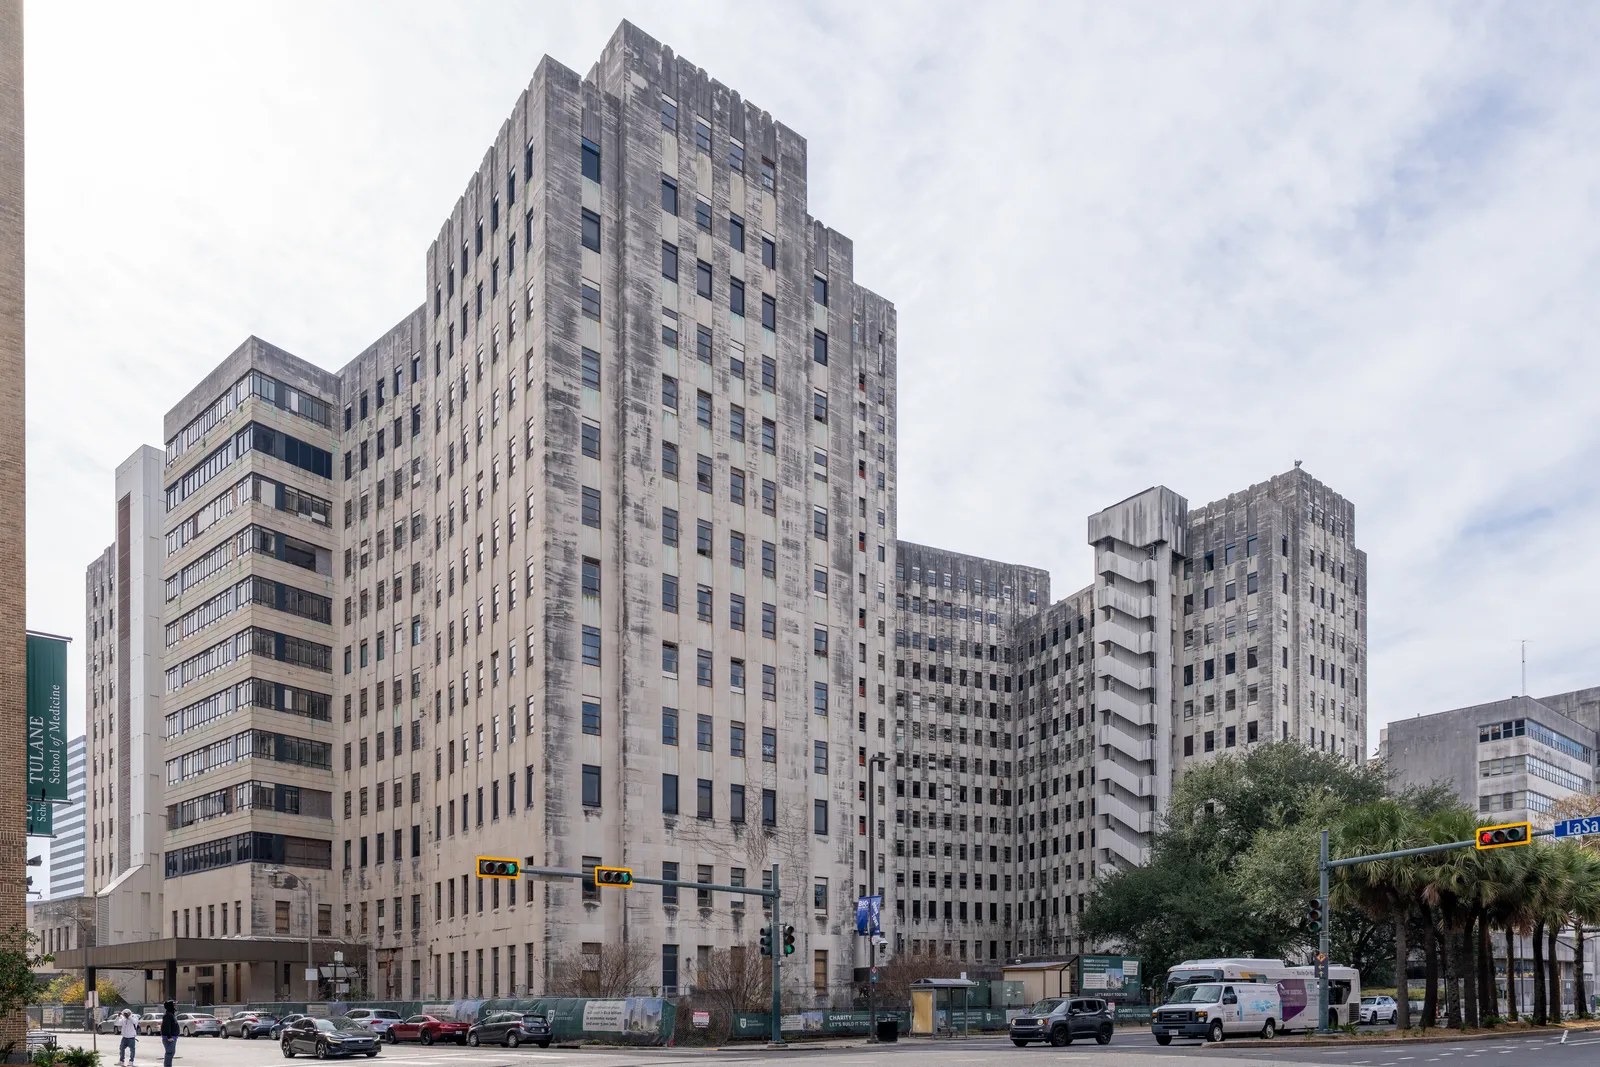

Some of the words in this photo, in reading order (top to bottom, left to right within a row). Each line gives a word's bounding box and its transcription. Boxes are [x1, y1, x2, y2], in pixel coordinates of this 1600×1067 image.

[48, 684, 61, 733] Medicine
[29, 716, 44, 784] TULANE
[49, 734, 64, 747] of
[48, 749, 61, 784] School
[1566, 818, 1599, 835] LaSa
